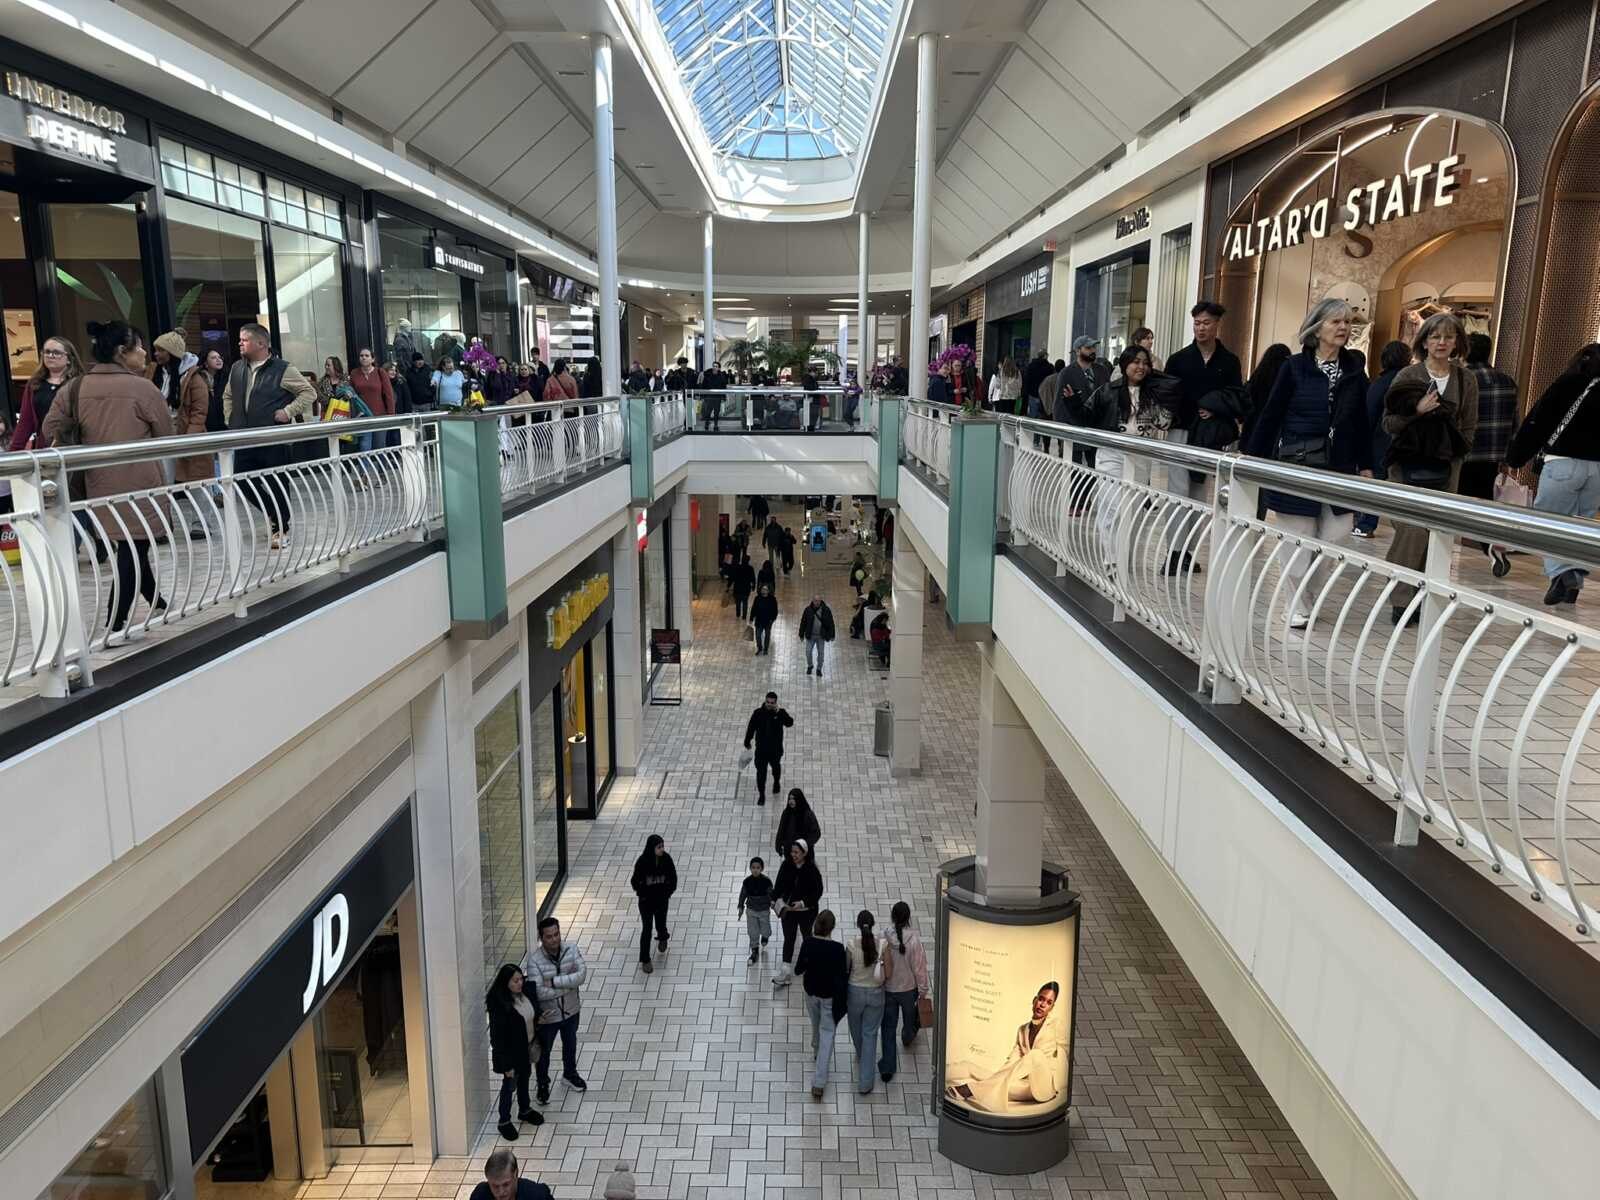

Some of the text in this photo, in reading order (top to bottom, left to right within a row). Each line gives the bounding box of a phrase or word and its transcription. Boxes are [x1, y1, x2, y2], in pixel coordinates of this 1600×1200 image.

[6, 72, 127, 134] INTERIOR
[26, 114, 118, 163] DEFINE
[1343, 155, 1460, 232] STATE
[1021, 269, 1038, 297] LUSH
[303, 892, 350, 1014] JD
